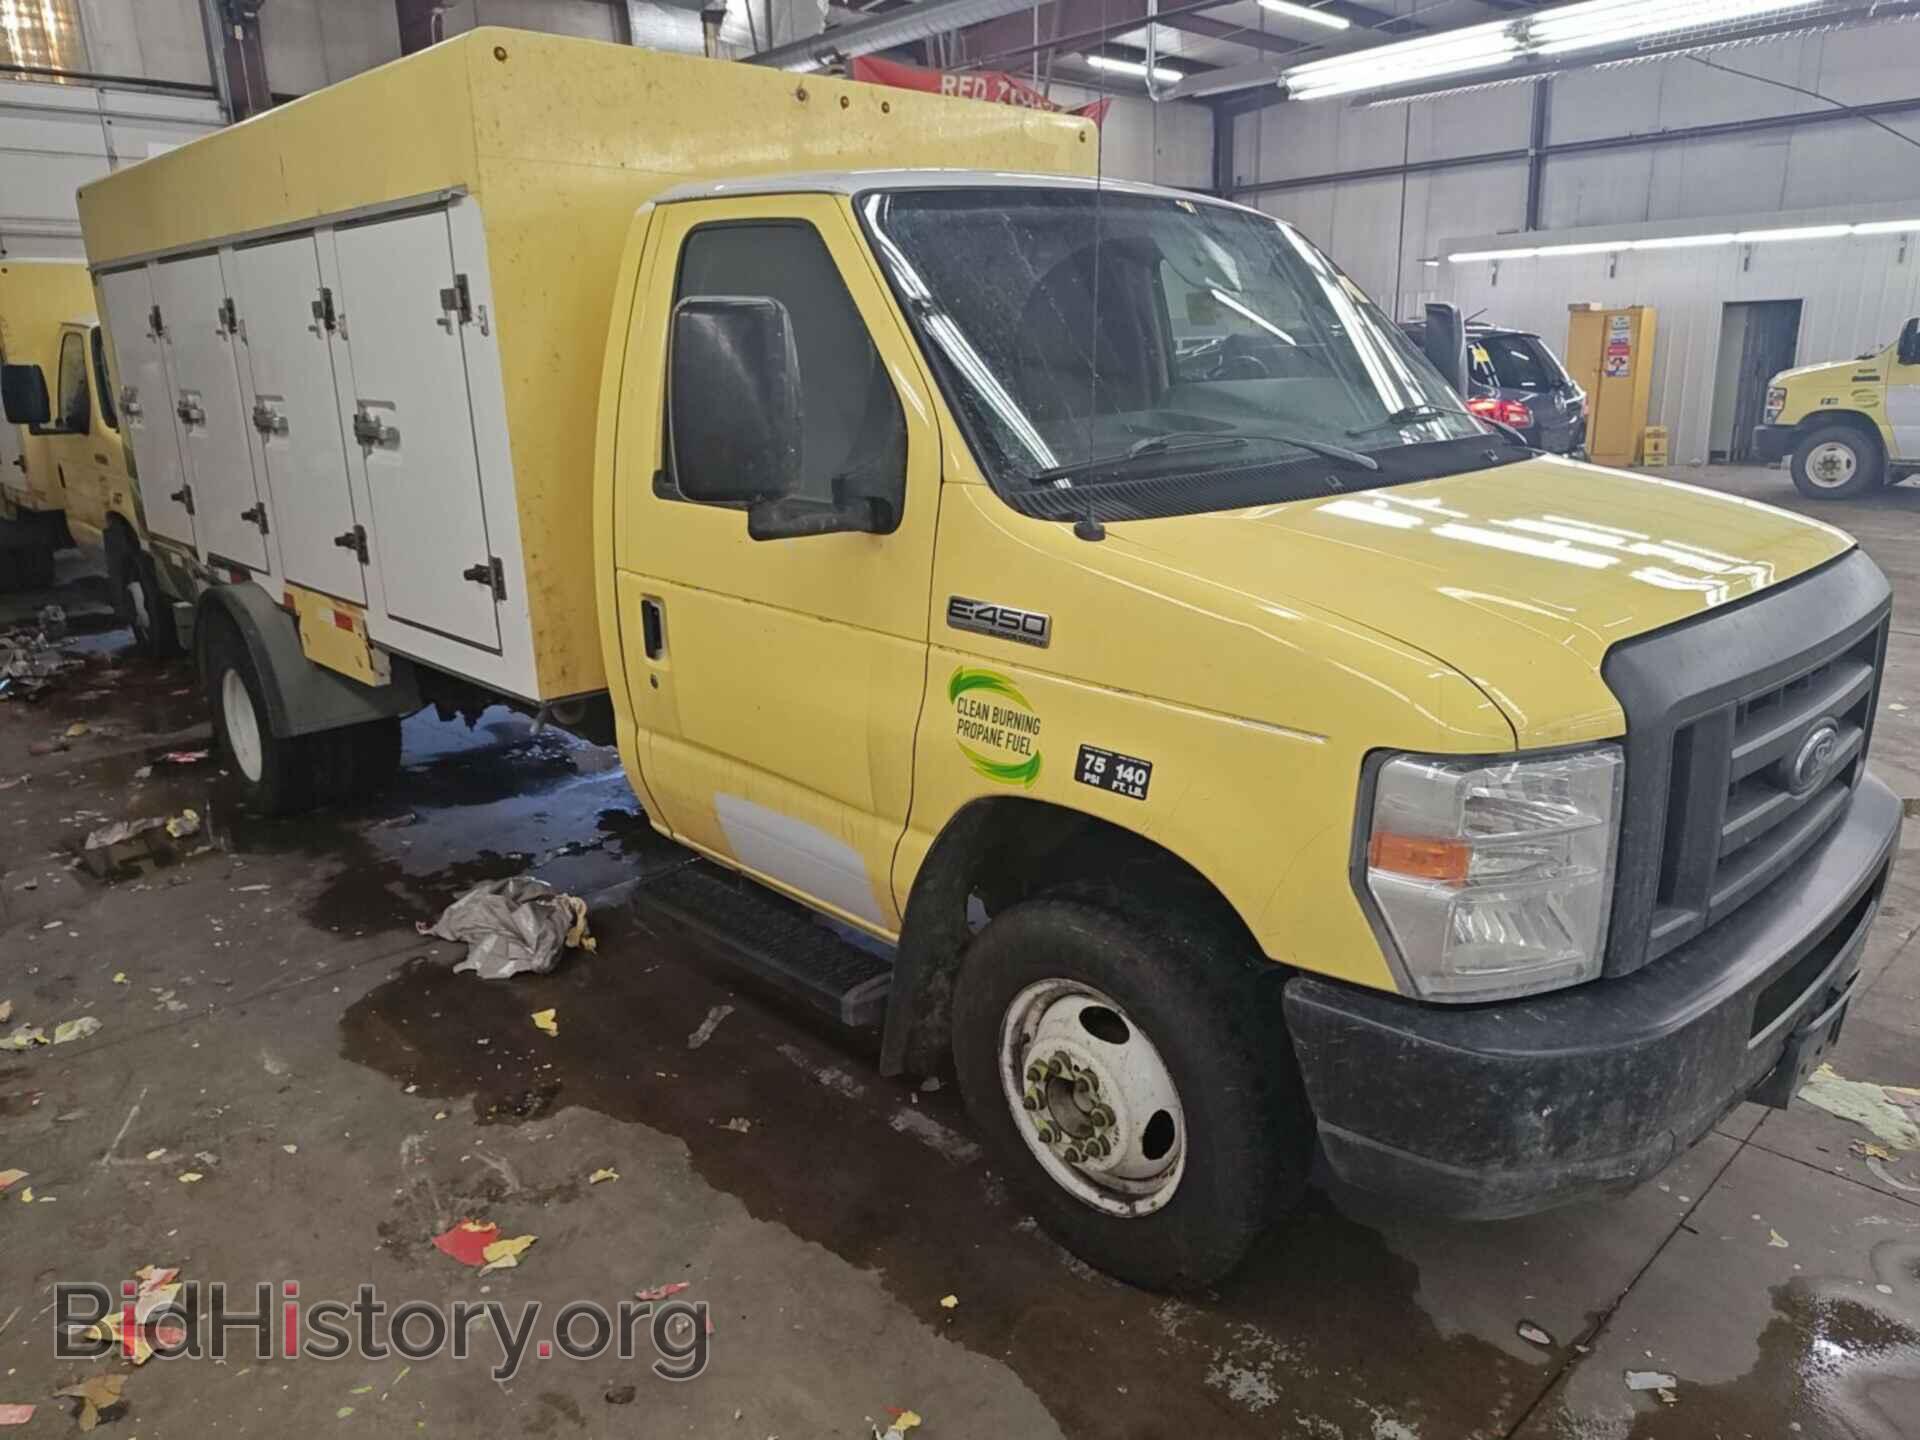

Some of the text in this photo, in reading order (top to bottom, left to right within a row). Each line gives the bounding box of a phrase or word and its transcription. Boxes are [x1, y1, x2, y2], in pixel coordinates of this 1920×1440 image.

[941, 75, 988, 99] RED
[957, 697, 1041, 735] CLEAN BURNING
[956, 718, 1032, 756] PROPANE FUEL
[1084, 753, 1106, 773] 75
[1116, 764, 1147, 786] 140
[1084, 772, 1100, 784] PSI
